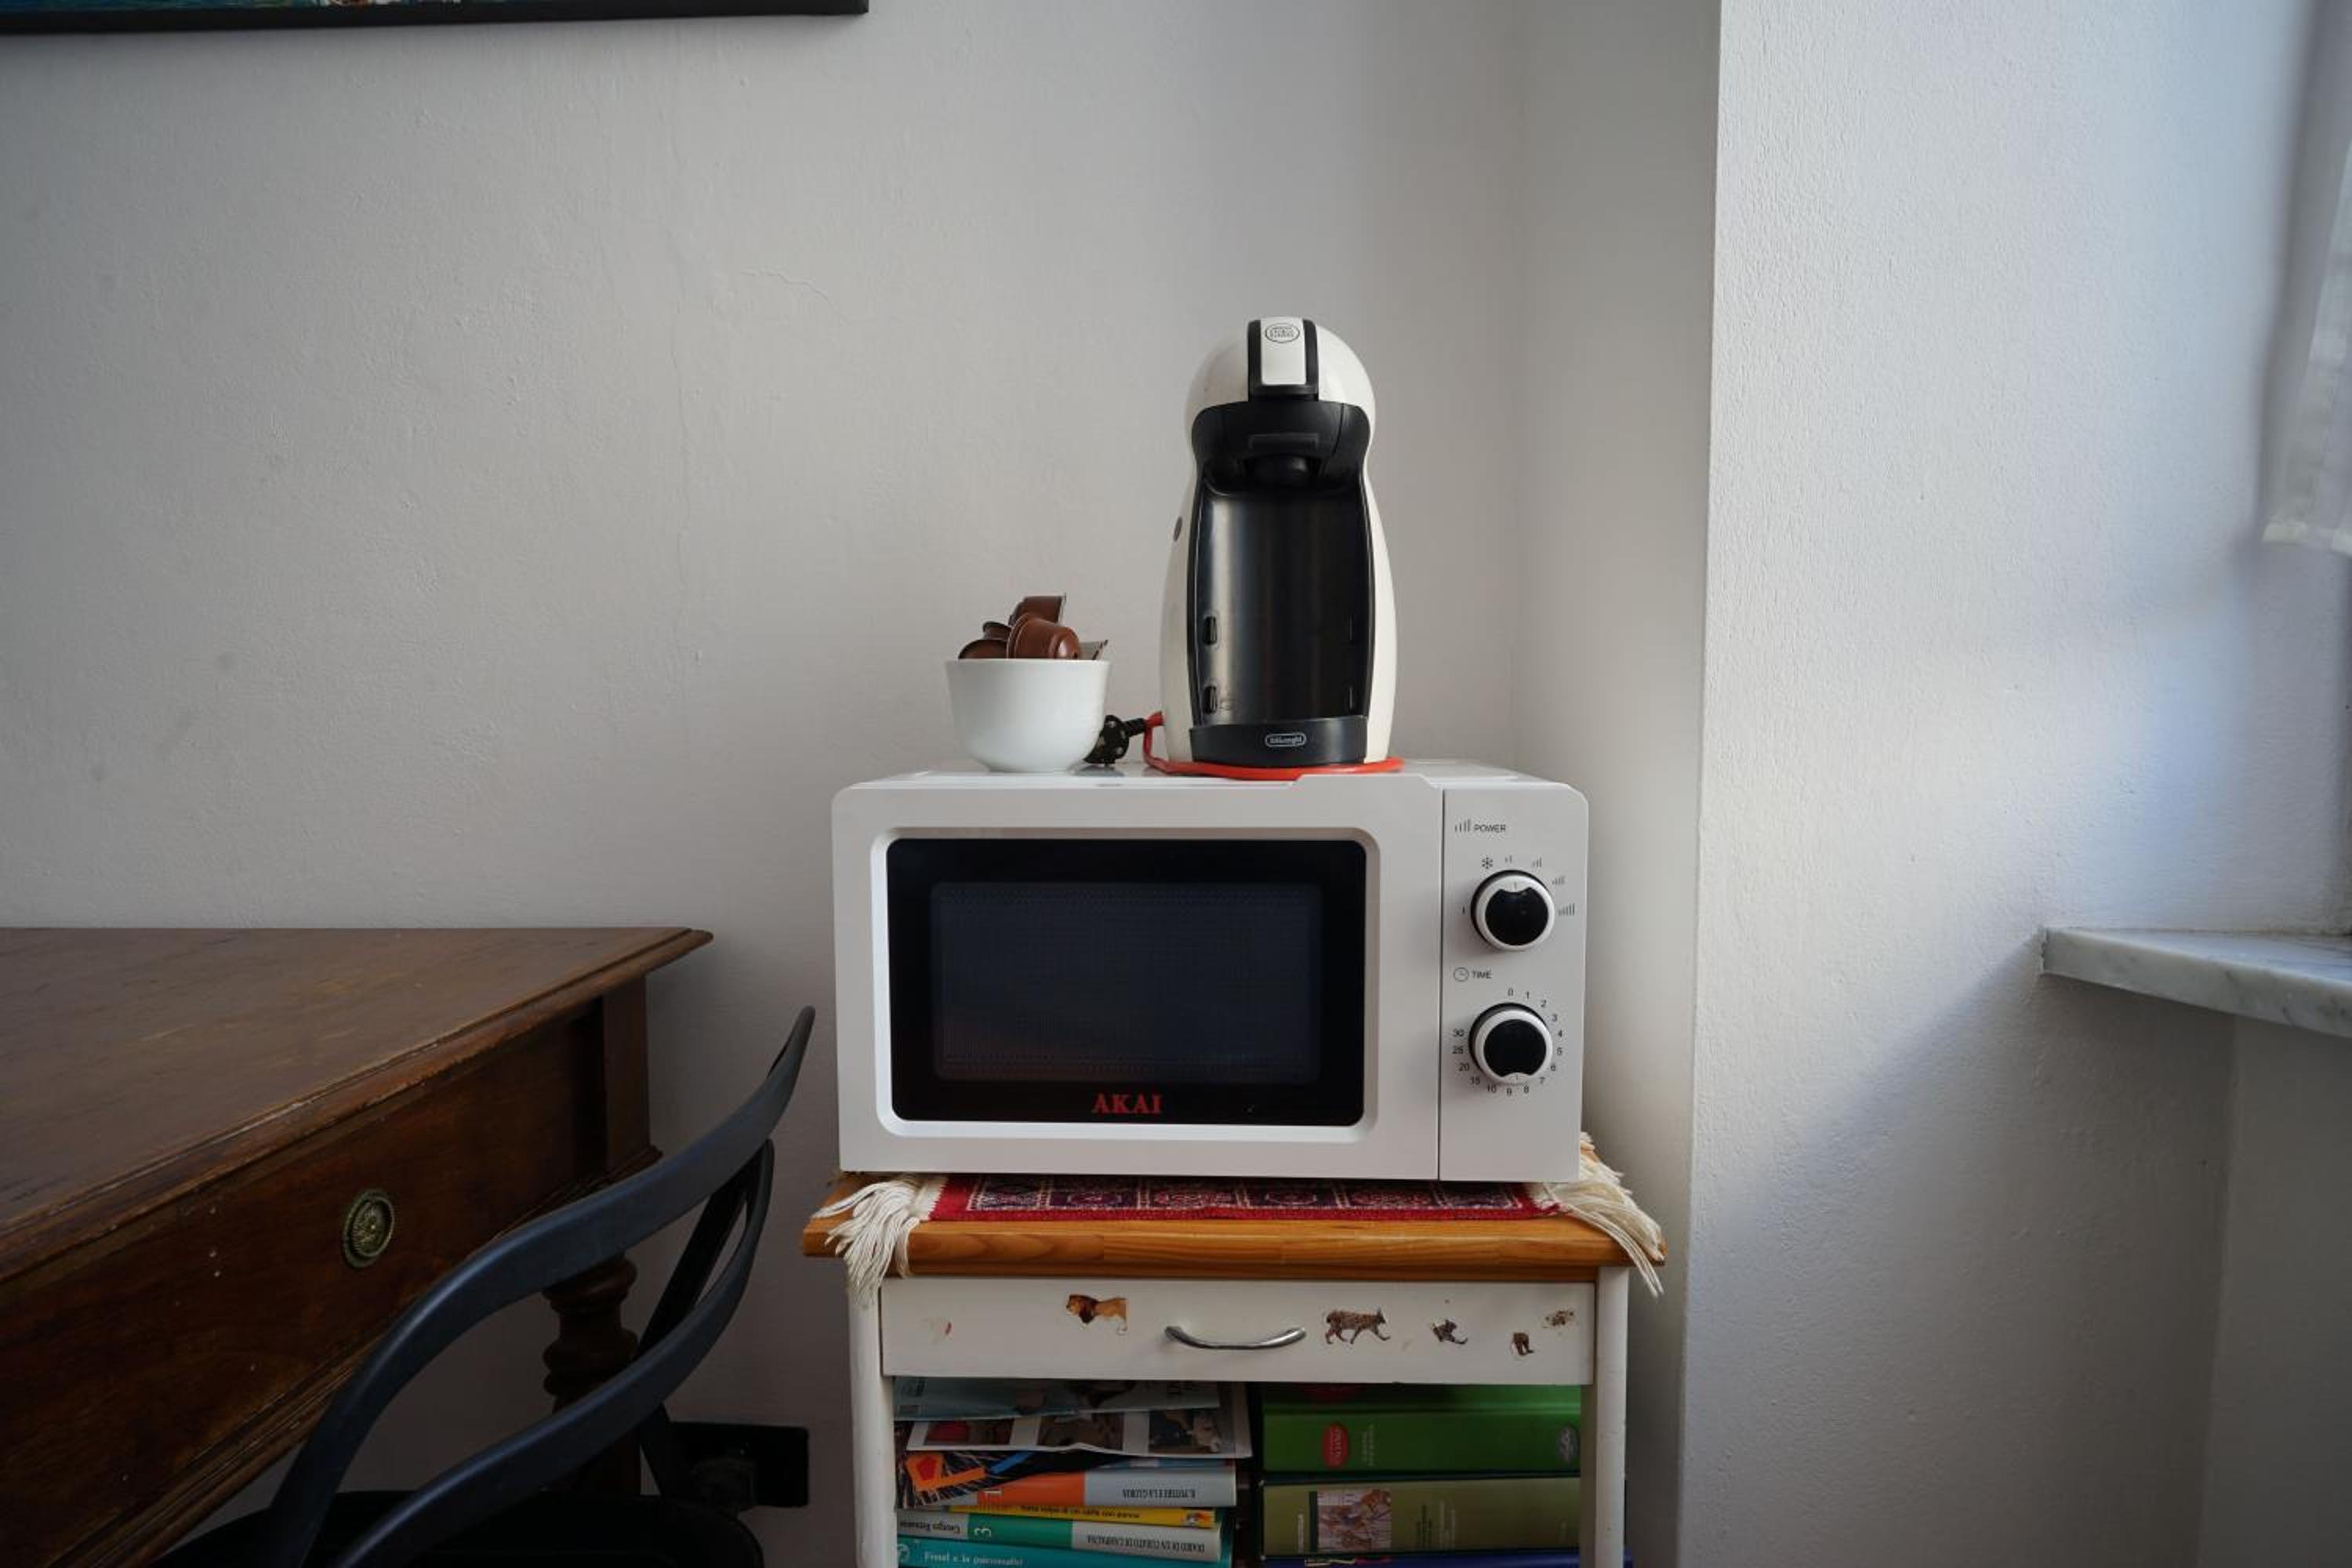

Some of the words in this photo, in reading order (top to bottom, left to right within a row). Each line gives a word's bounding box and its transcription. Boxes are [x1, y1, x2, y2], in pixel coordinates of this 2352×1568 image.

[1474, 823, 1505, 833] POWER
[1472, 970, 1492, 979] TIME
[1508, 987, 1514, 996] 0
[1540, 999, 1547, 1008] 2
[1556, 1029, 1563, 1038] 4
[1091, 1092, 1163, 1114] AKAI
